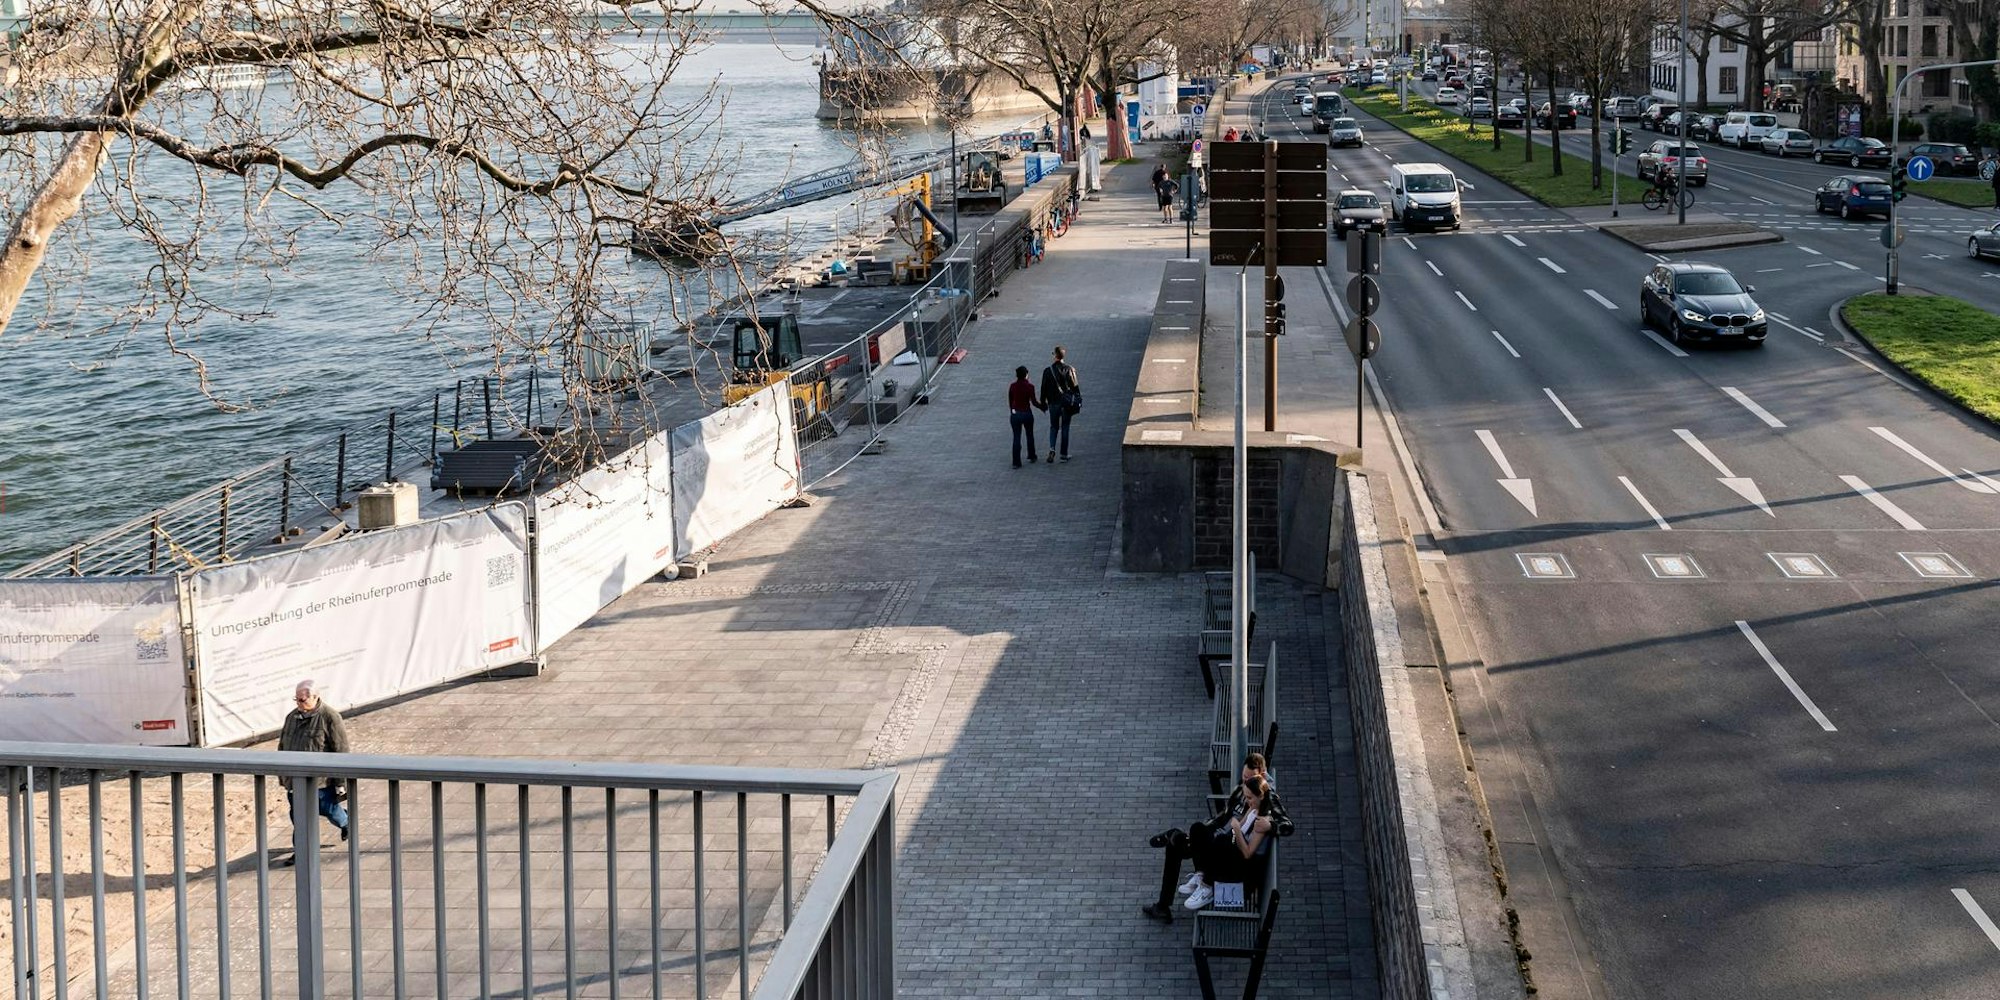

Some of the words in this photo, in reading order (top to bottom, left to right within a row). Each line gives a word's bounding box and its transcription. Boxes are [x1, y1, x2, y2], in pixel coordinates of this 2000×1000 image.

[211, 605, 303, 637] Umgestaltung
[306, 600, 325, 614] der
[328, 571, 453, 608] Rheinuferpromenade
